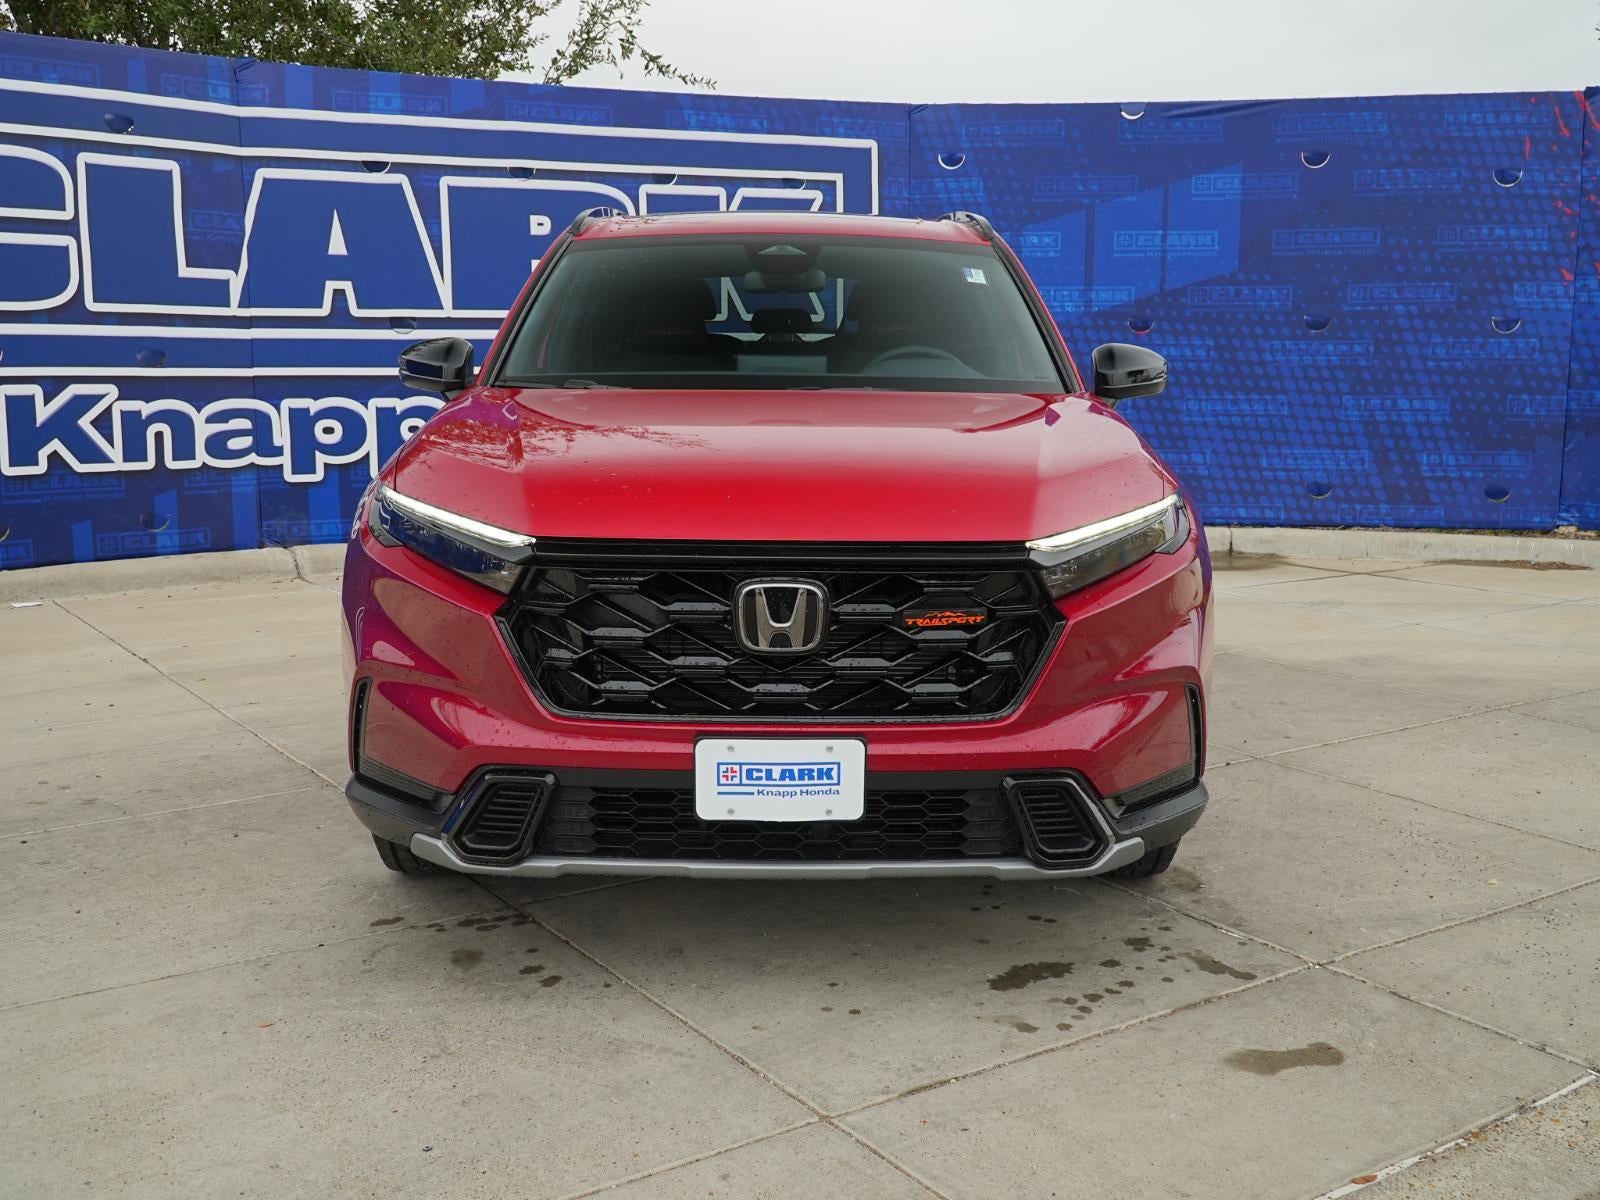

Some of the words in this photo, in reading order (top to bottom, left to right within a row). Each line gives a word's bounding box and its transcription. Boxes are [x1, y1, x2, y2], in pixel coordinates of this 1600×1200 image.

[904, 614, 985, 627] TRAILSPORT
[745, 767, 835, 782] CLARK
[756, 788, 798, 799] Knapp
[799, 787, 840, 797] Honda
